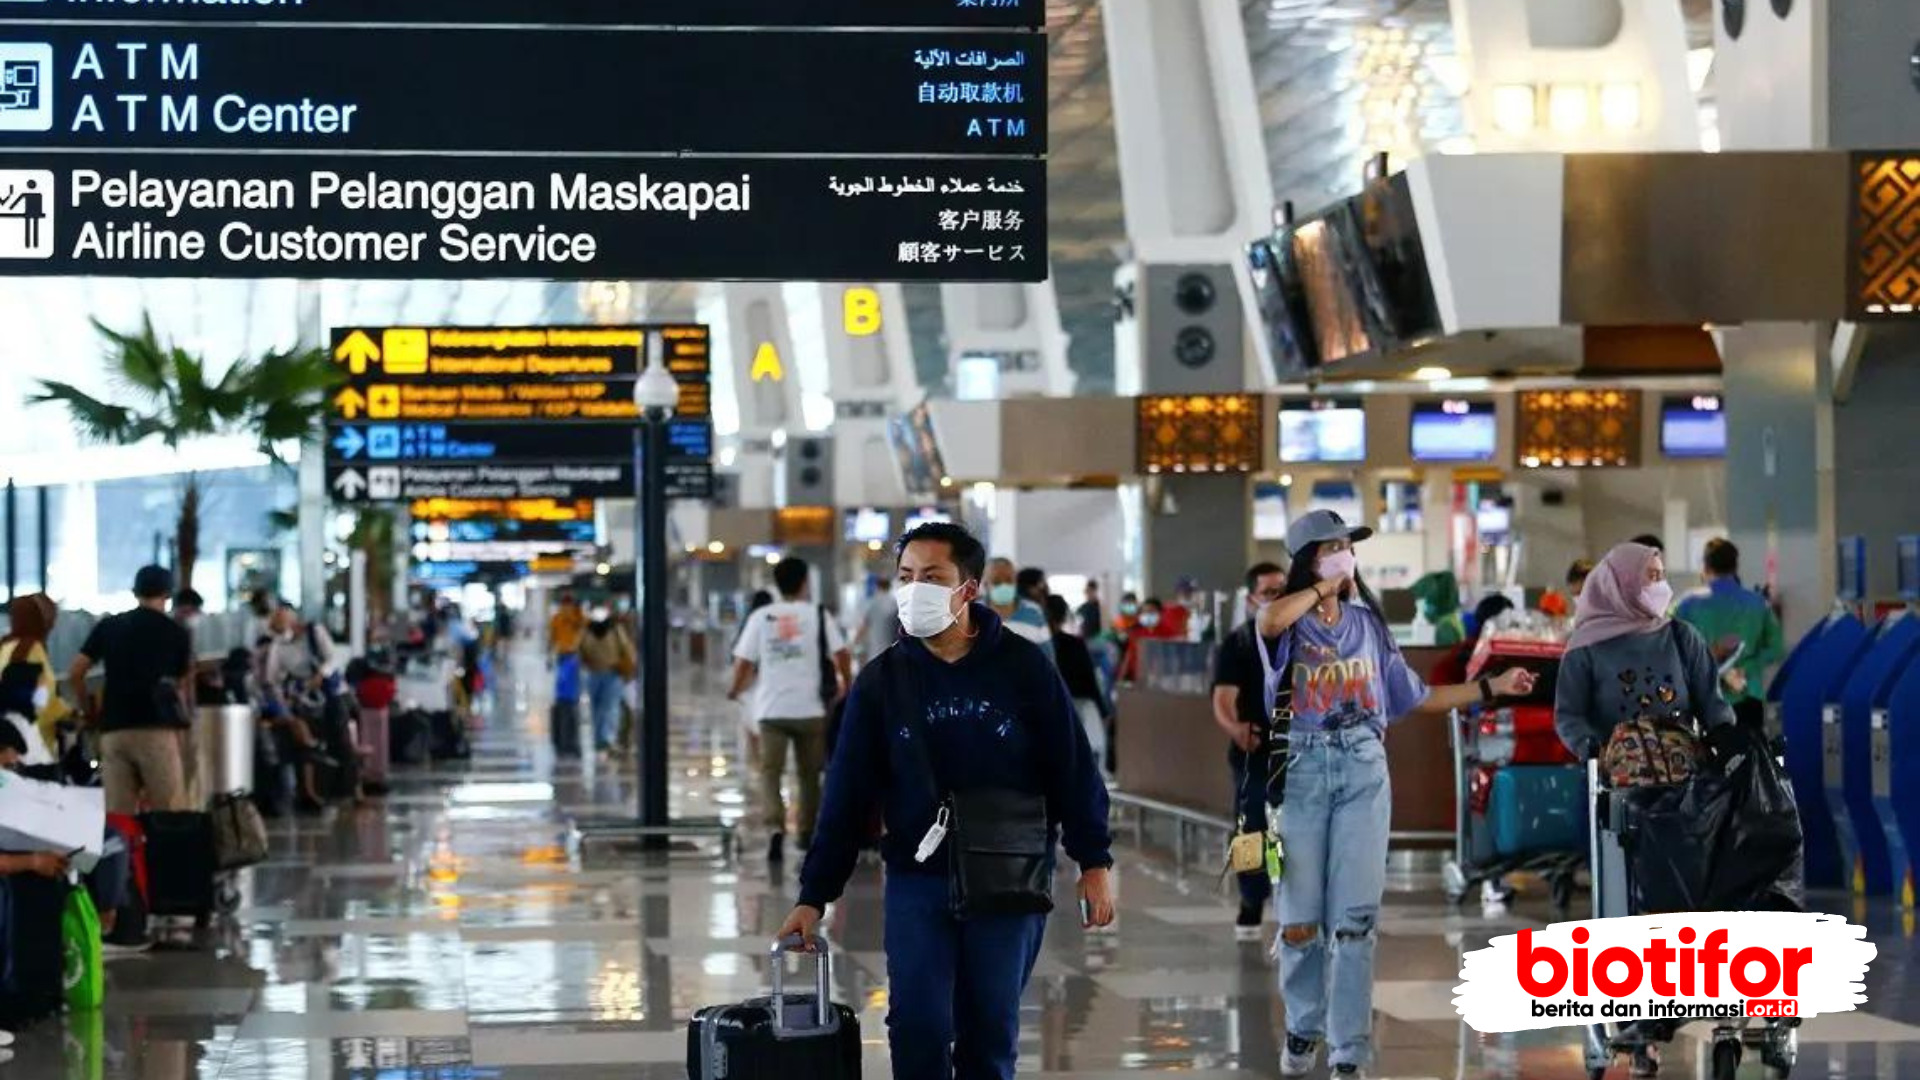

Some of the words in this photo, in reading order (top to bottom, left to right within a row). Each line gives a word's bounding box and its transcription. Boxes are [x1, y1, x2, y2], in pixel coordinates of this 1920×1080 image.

[954, 49, 1025, 71] الصرافات
[918, 81, 1025, 104] 自动取款机
[213, 93, 358, 134] Center
[71, 169, 295, 218] Pelayanan
[310, 170, 535, 219] Pelanggan
[550, 172, 750, 220] Maskapai
[828, 176, 875, 197] الجوية
[876, 176, 935, 197] الخطوط
[939, 176, 982, 194] عملاء
[986, 176, 1025, 193] خدمة
[938, 208, 1024, 231] 客户服务
[71, 220, 206, 262] Airline
[219, 221, 428, 263] Customer
[438, 222, 597, 263] Service
[897, 241, 1026, 264] 顧客サービス
[843, 287, 882, 336] B
[750, 341, 783, 382] A
